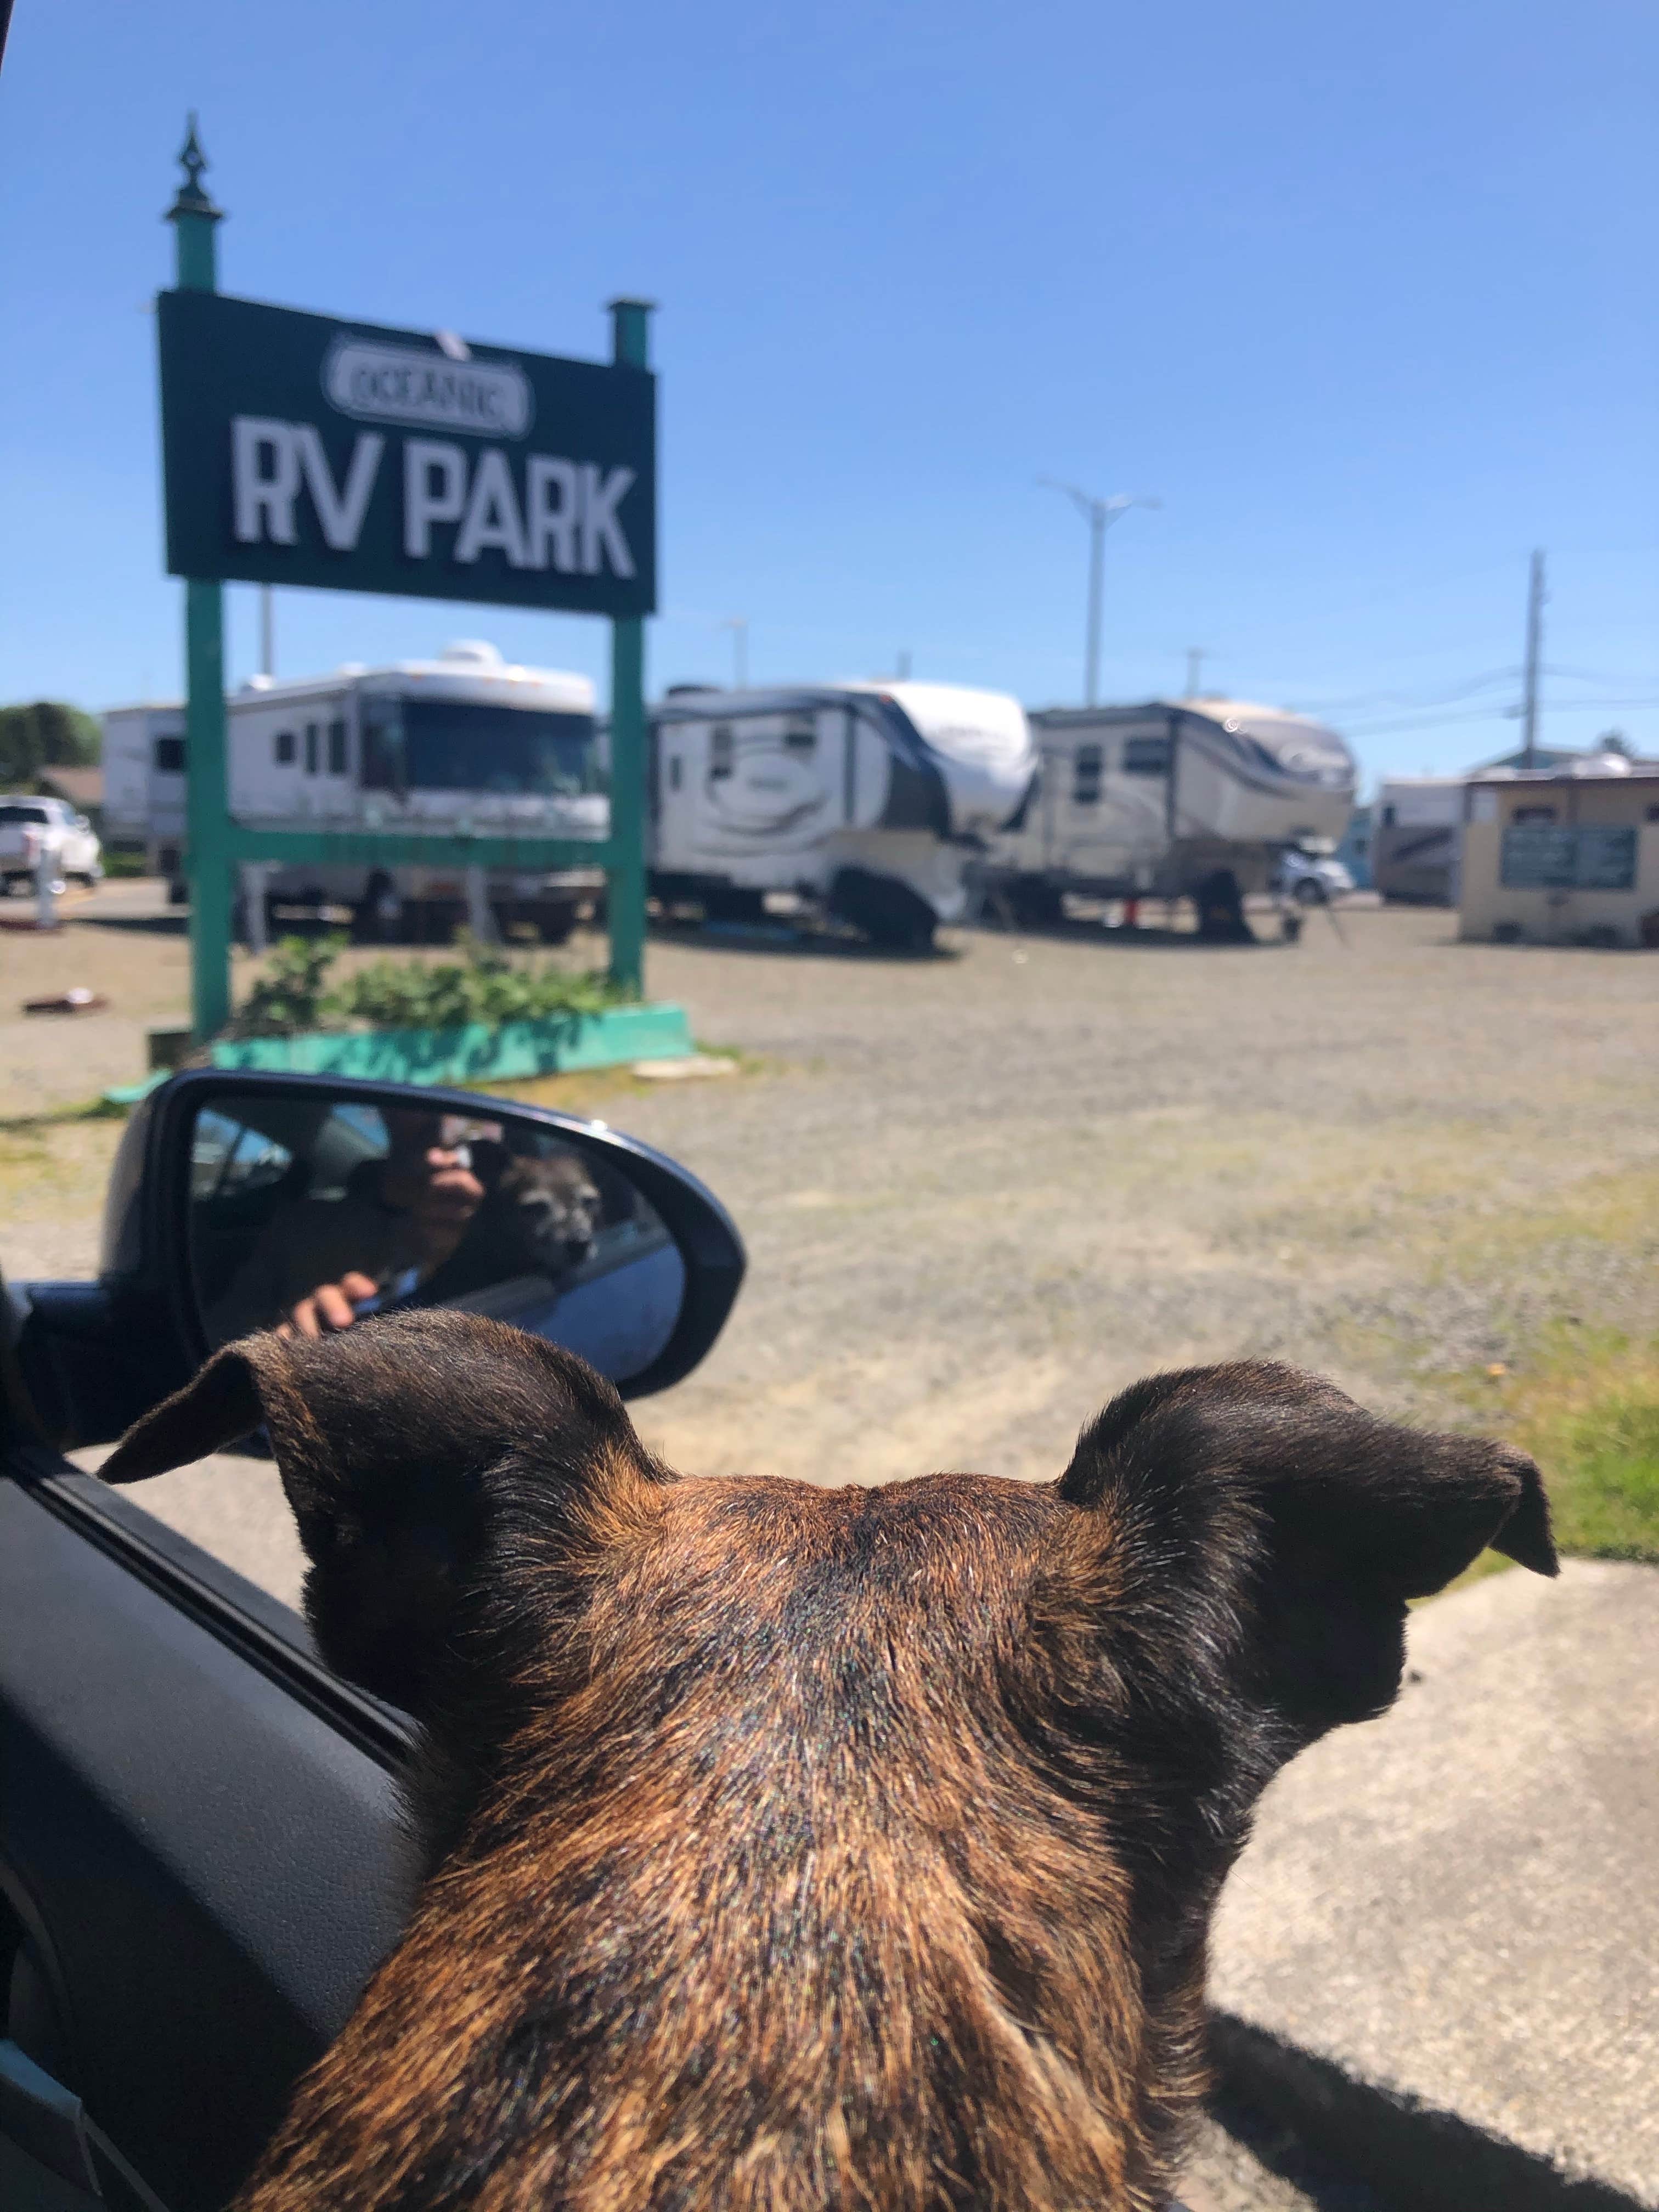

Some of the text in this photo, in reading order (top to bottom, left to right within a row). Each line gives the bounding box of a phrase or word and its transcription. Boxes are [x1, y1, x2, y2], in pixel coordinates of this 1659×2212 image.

[350, 363, 501, 418] OCEANIC
[231, 415, 636, 578] RV PARK
